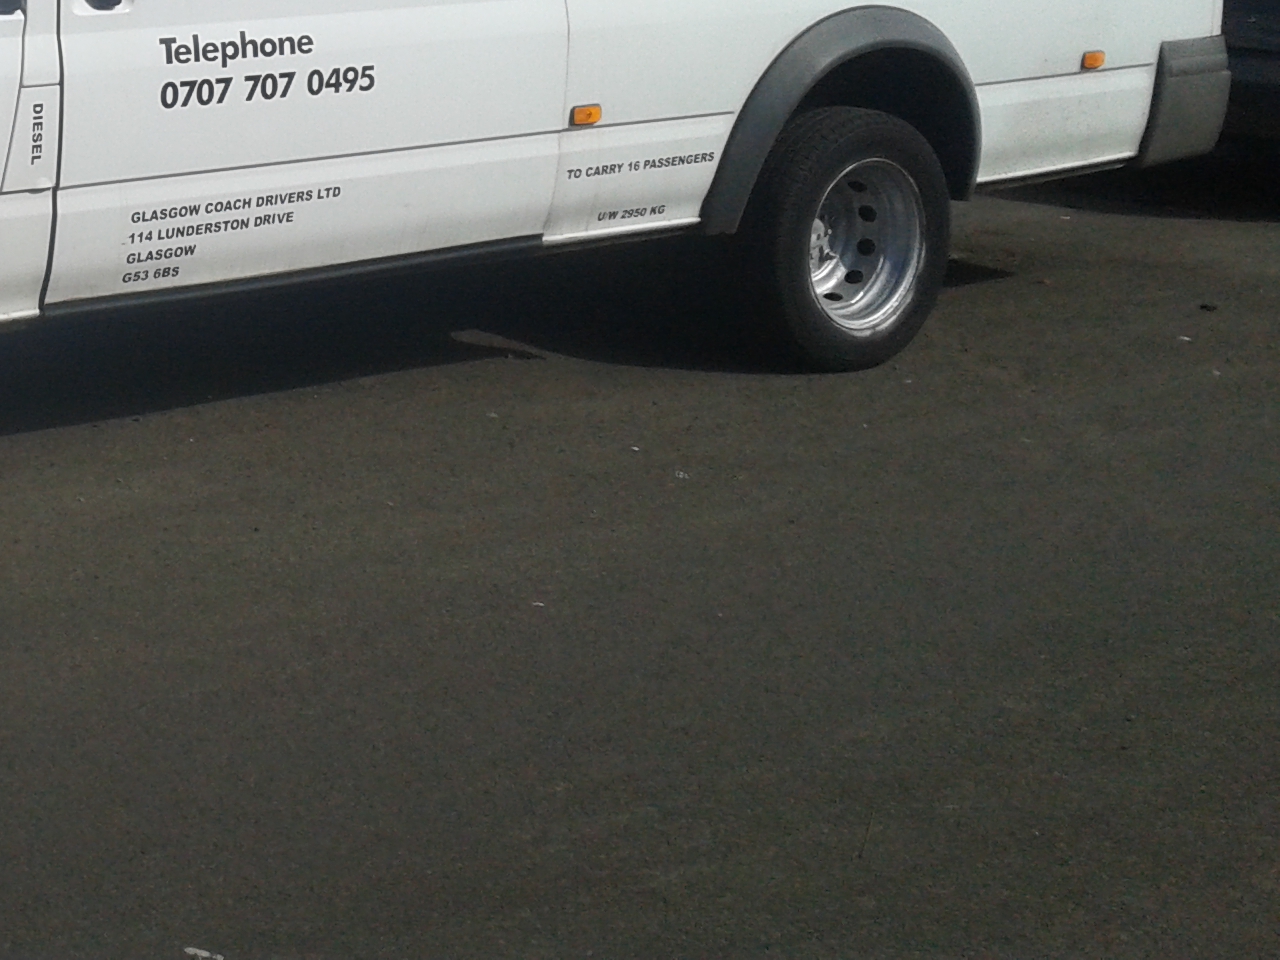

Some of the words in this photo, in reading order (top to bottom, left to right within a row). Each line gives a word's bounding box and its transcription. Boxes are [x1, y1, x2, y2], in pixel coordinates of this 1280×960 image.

[159, 31, 314, 68] Telephone
[160, 77, 233, 109] 0707
[244, 72, 296, 101] 707
[307, 65, 375, 96] 0495
[31, 103, 43, 165] DIESEL
[567, 168, 582, 180] TO
[585, 162, 624, 178] CARRY
[628, 161, 640, 171] 16
[643, 152, 715, 170] PASSENGERS
[131, 204, 201, 224] GLASGOW
[205, 197, 251, 215] COACH
[256, 189, 313, 208] DRIVERS
[317, 186, 341, 200] LTD
[620, 207, 648, 219] 2950
[649, 204, 666, 216] KG
[128, 231, 153, 245] 114
[157, 217, 249, 241] LUNDERSTON
[254, 211, 294, 228] DRIVE
[126, 244, 197, 264] GLASGOW
[122, 270, 149, 283] G53
[153, 266, 180, 280] 6BS
